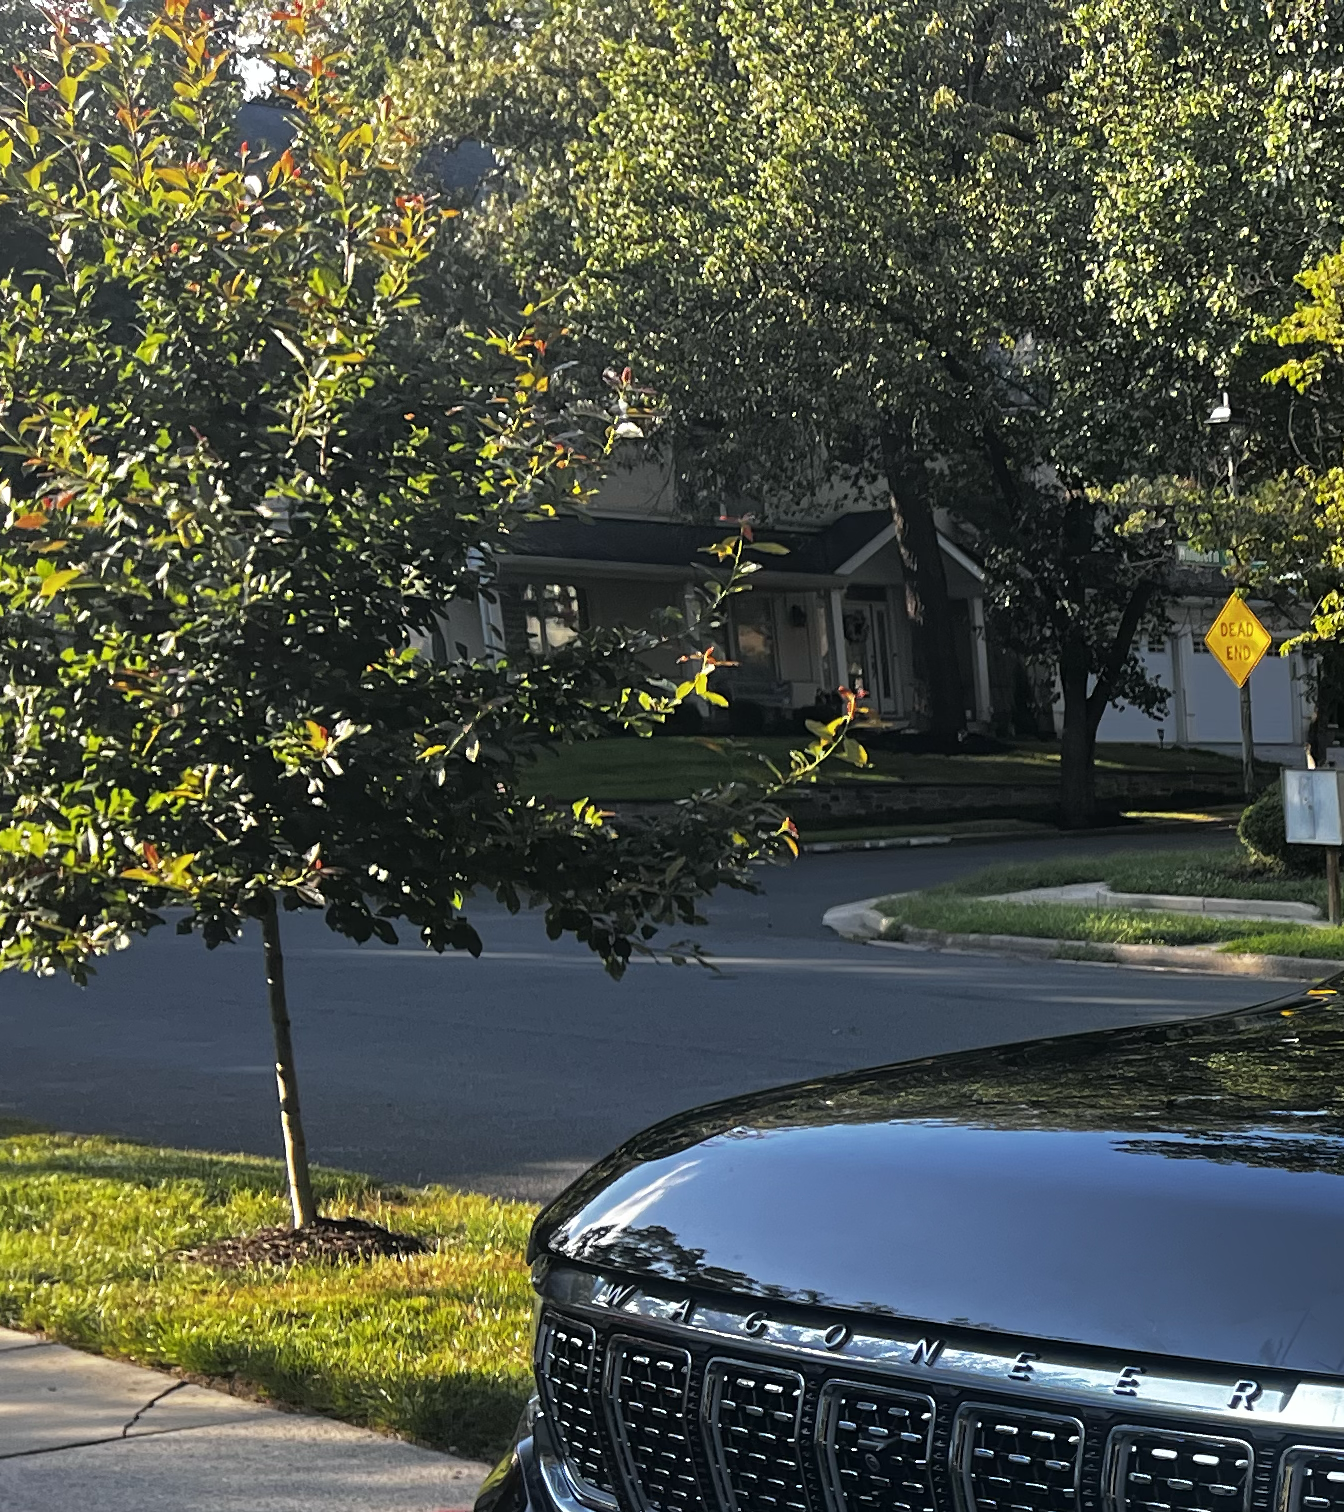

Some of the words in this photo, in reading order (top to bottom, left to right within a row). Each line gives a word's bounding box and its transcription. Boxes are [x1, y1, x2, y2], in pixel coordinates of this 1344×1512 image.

[1220, 622, 1254, 637] DEAD
[1226, 645, 1251, 661] END
[595, 1283, 1263, 1412] WAGONEER
